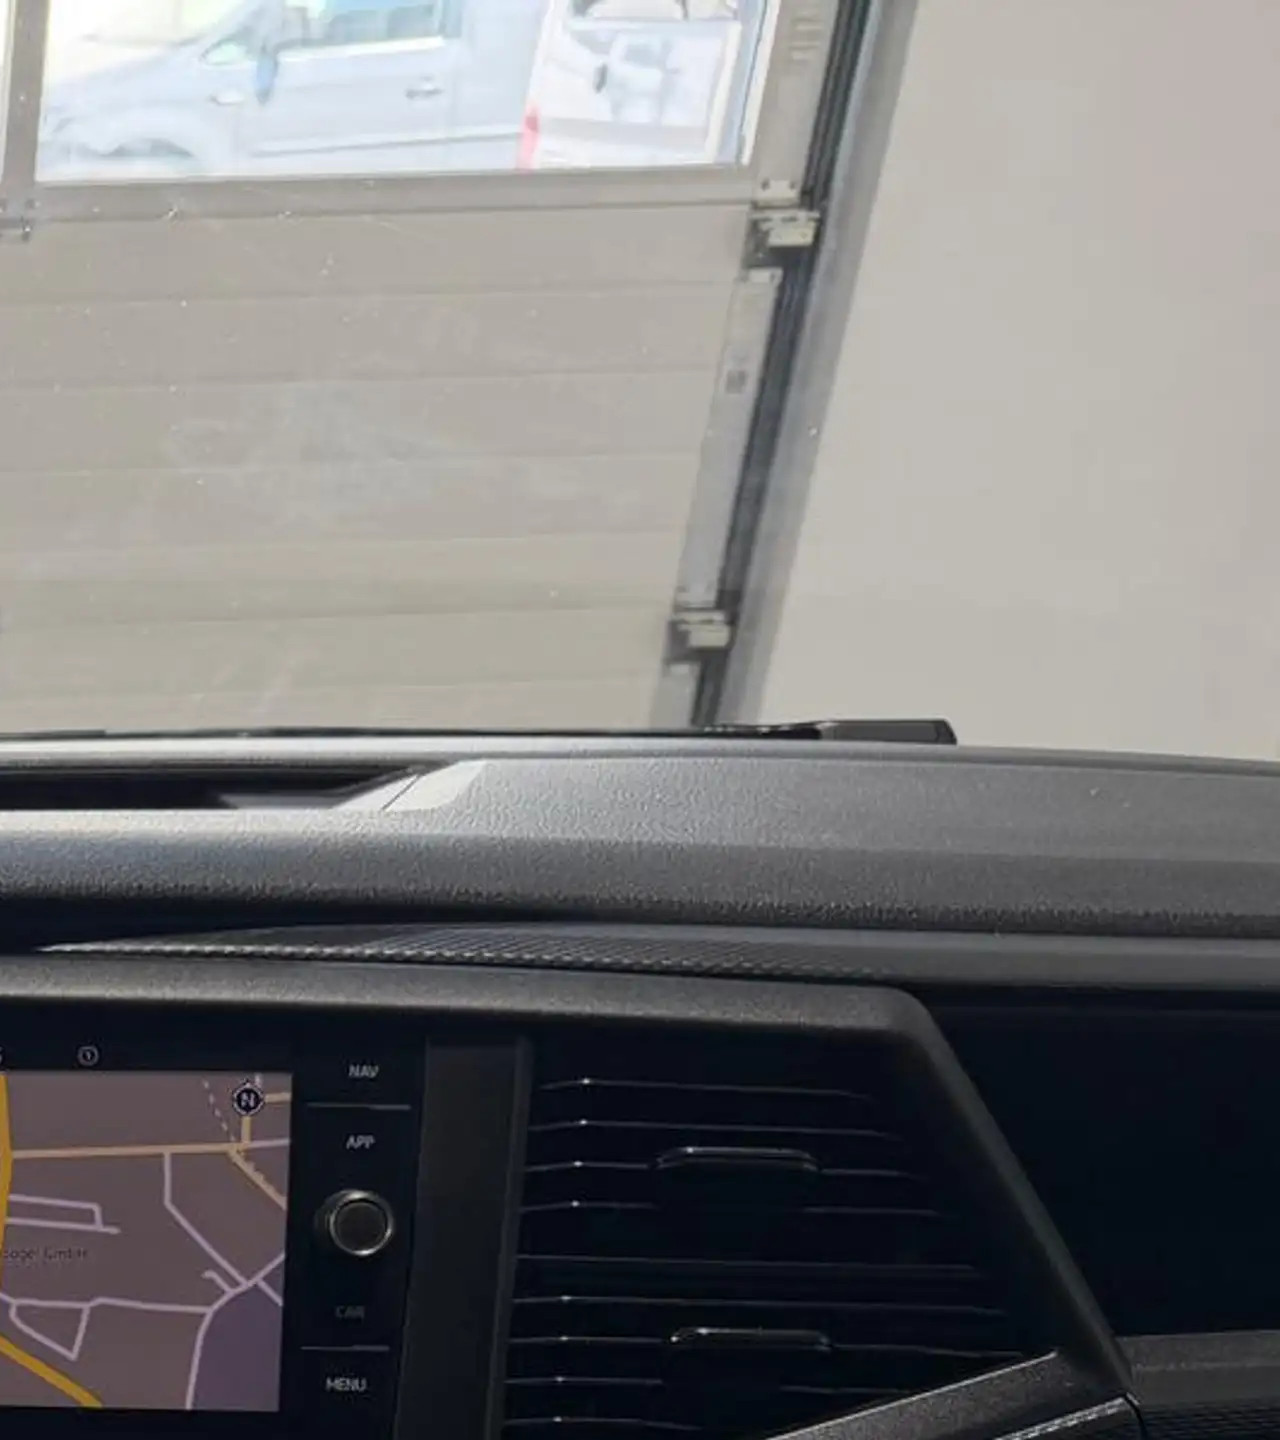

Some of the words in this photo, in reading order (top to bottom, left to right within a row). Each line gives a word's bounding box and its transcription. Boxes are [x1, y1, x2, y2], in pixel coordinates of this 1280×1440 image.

[347, 1063, 379, 1079] NAV
[345, 1134, 376, 1150] APP
[325, 1376, 367, 1393] MENU
